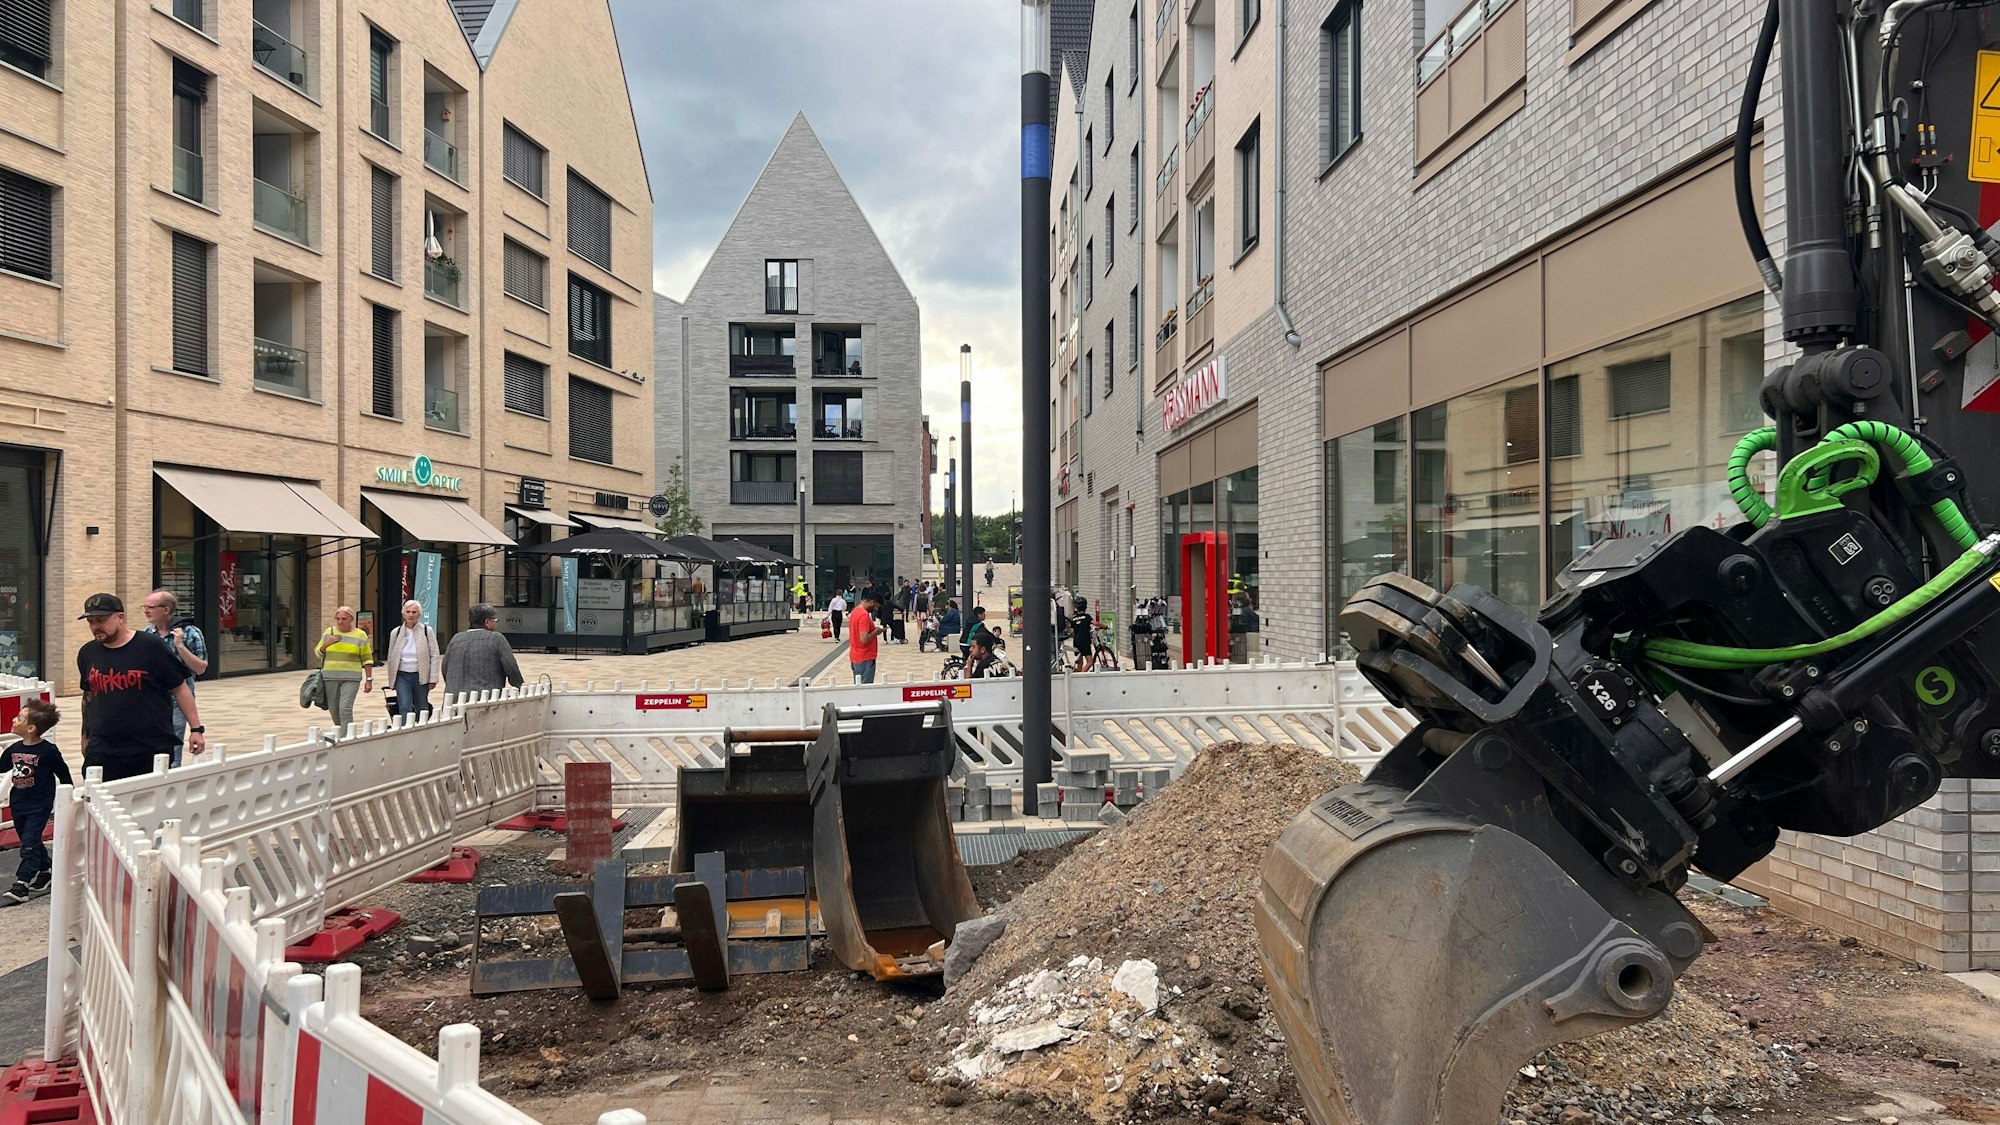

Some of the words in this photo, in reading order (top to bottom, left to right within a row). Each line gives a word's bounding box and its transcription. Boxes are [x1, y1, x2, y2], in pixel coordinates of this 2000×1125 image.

[1163, 361, 1218, 432] ROSSMANN
[376, 467, 412, 483] SMILE
[431, 474, 461, 491] OPTIC
[426, 556, 435, 591] OPTIC
[643, 698, 682, 706] ZEPPELIN
[910, 689, 948, 698] ZEPPELIN
[1587, 679, 1617, 711] X26
